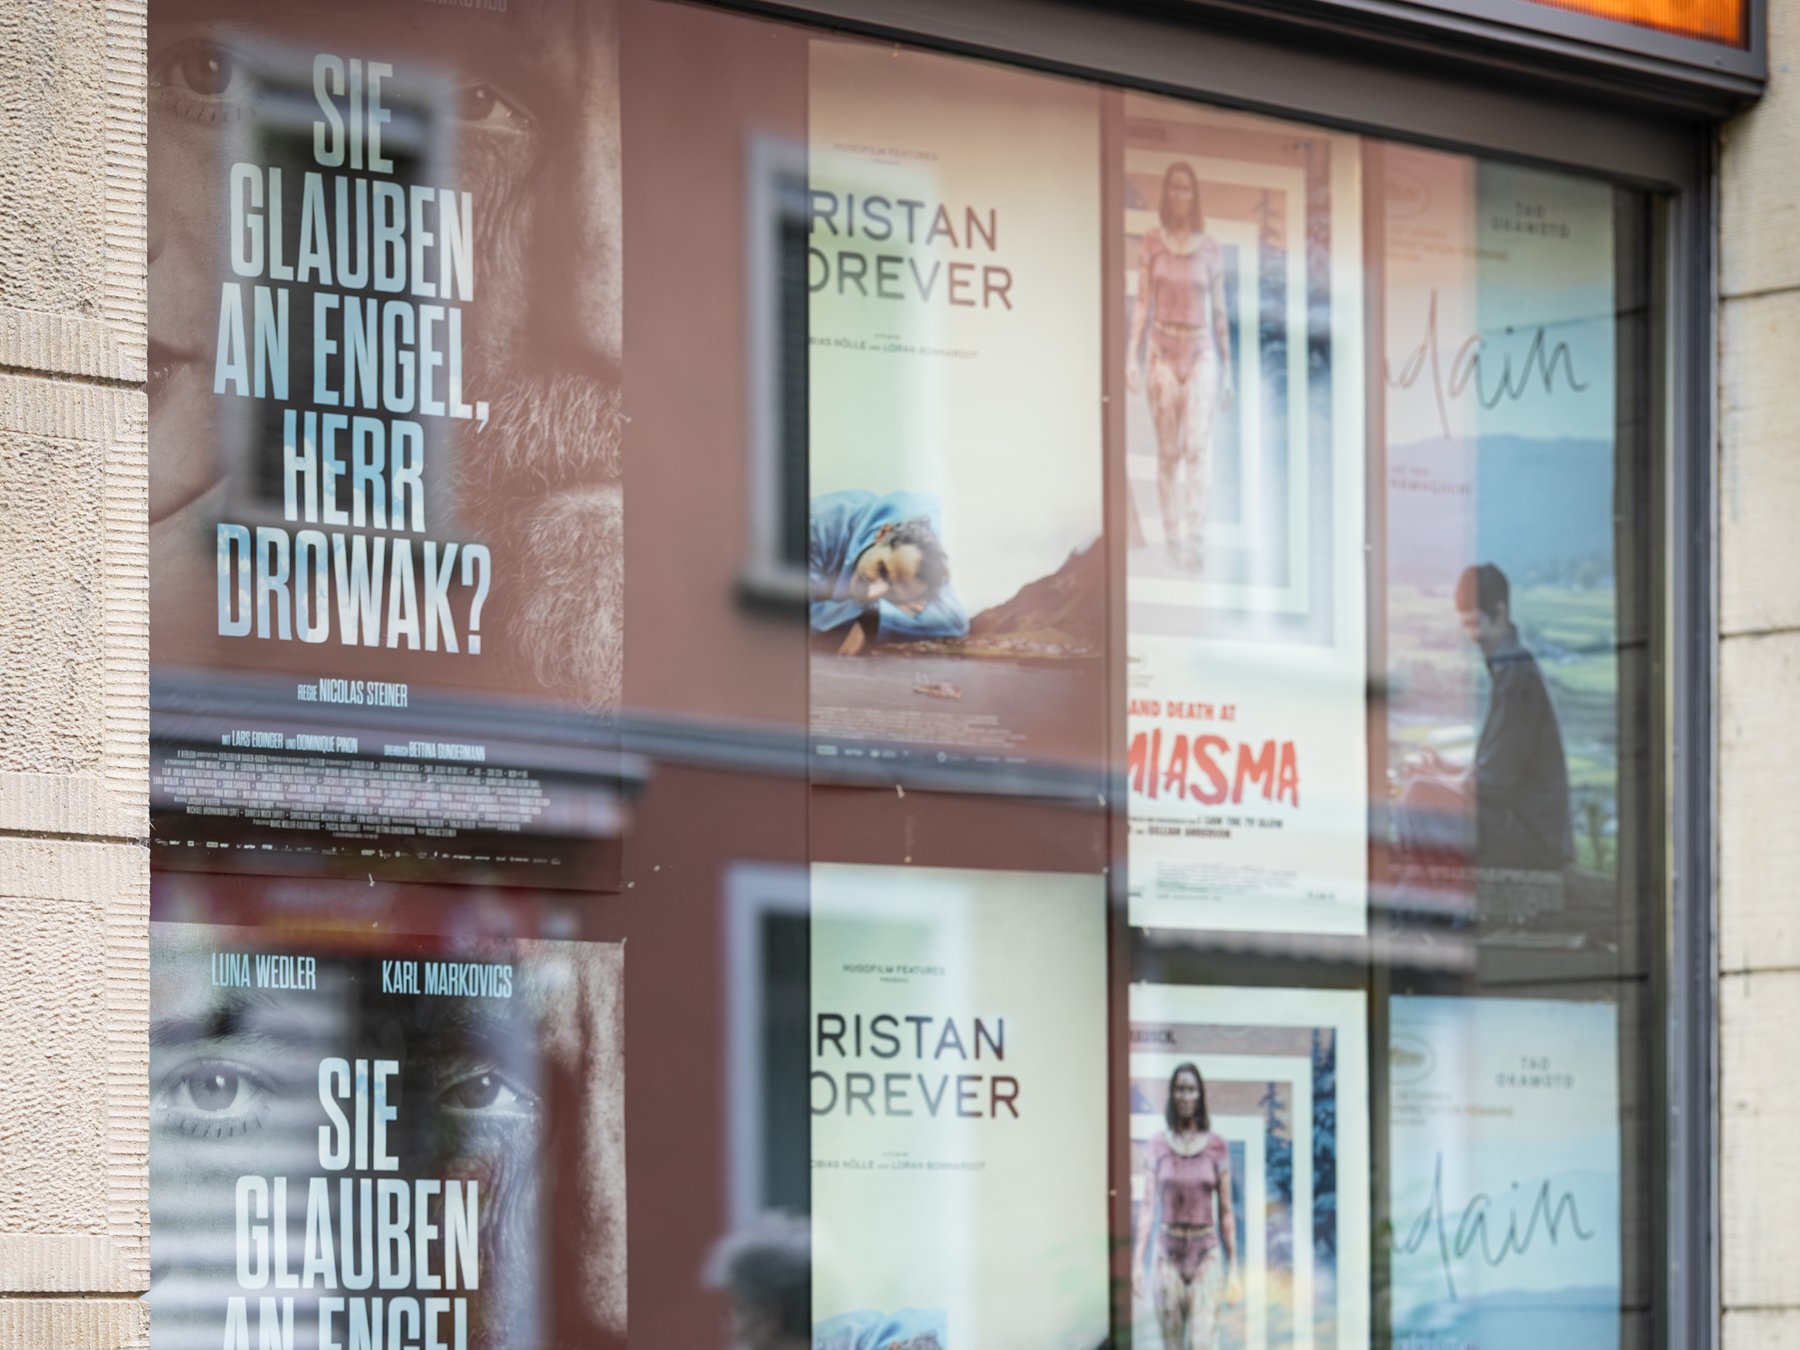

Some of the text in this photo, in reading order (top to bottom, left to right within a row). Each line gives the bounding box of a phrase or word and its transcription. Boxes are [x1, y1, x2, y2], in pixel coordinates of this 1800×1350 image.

[312, 53, 394, 174] SIE
[229, 162, 473, 302] GLAUBEN
[809, 189, 997, 251] RISTAN
[213, 282, 489, 434] AN ENGEL,
[284, 409, 425, 533] HERR
[217, 523, 492, 655] DROWAK?
[298, 678, 408, 708] REGIE NICOLAS STEINER
[1128, 699, 1237, 721] AND DEATH AT
[232, 730, 251, 747] LARS
[408, 741, 436, 759] BETTINA
[1128, 727, 1300, 808] MIASMA
[211, 953, 316, 990] LUNA WEDLER
[382, 960, 512, 998] KARL MARKOVICS
[817, 1013, 1004, 1061] RISTAN
[318, 1057, 399, 1171] SIE
[810, 1070, 1020, 1119] OREVER
[235, 1175, 479, 1290] GLAUBEN
[1392, 1151, 1595, 1301] dain
